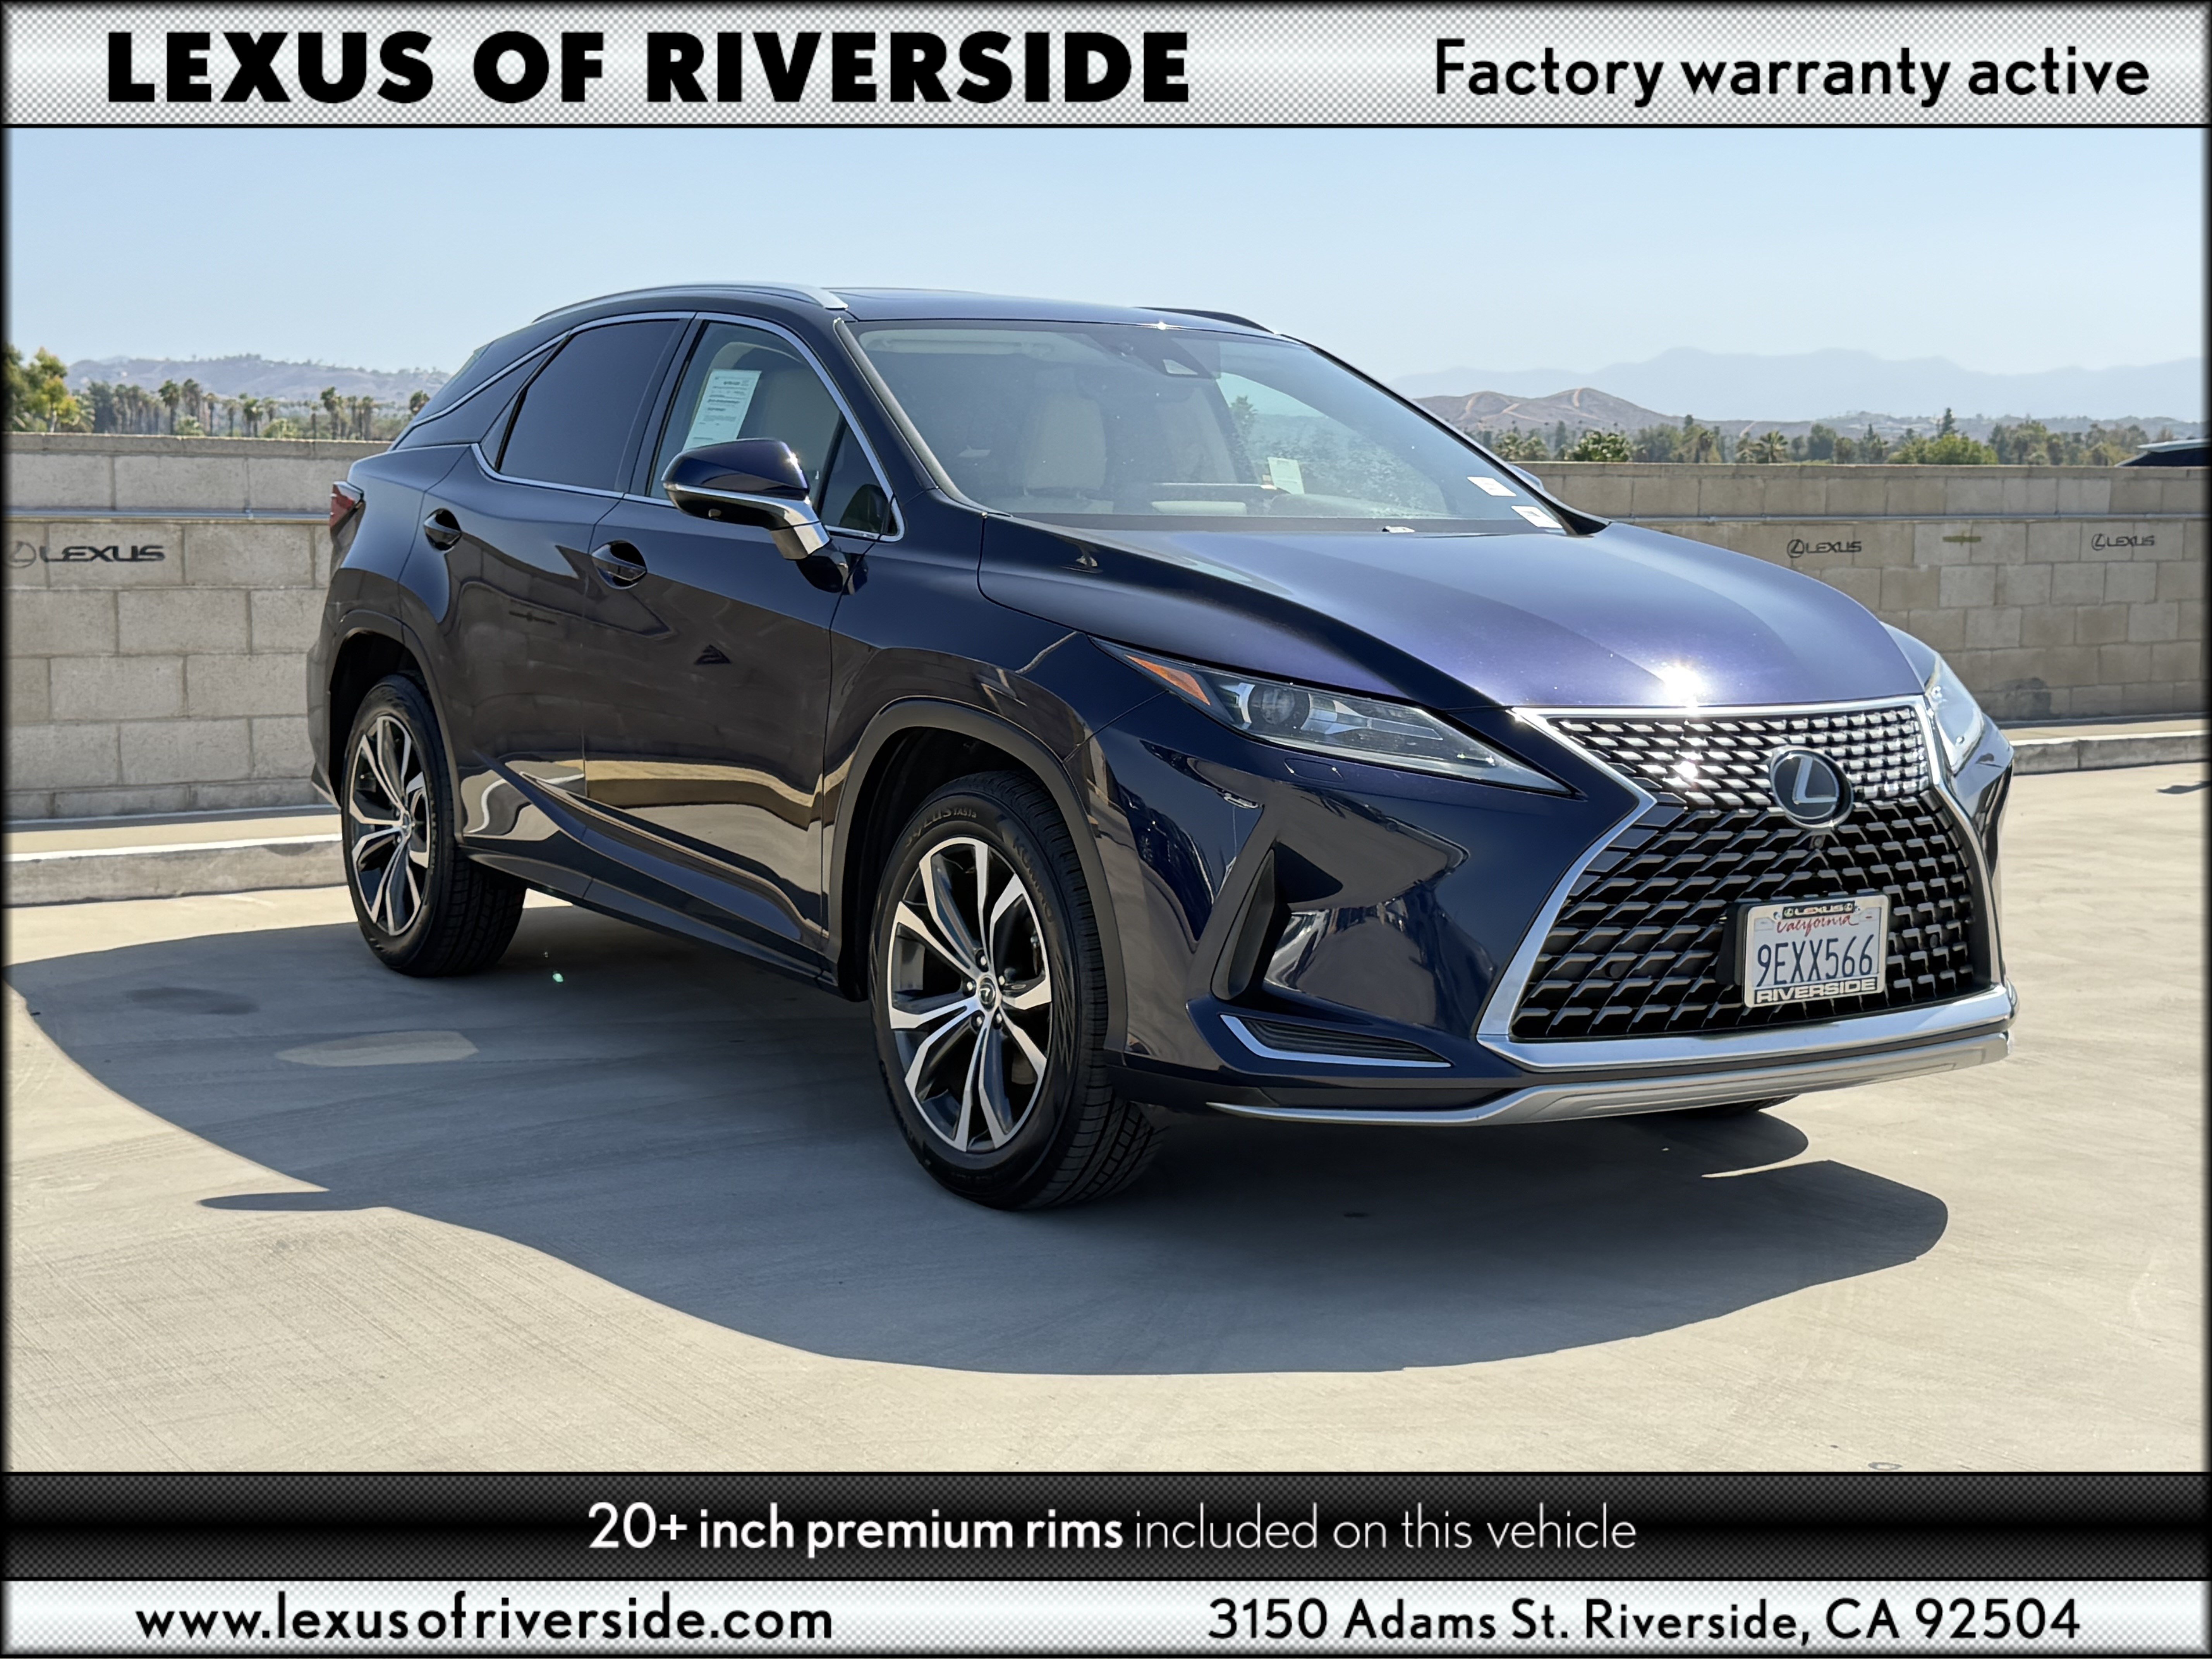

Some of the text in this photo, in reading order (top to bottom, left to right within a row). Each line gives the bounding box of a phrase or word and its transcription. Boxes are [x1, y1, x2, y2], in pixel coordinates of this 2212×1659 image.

[1806, 541, 1862, 553] LEXUS
[2107, 535, 2154, 546] LEXUS
[40, 545, 165, 563] LEXUS
[1795, 904, 1844, 915] LEXUS
[1777, 915, 1858, 937] California
[1757, 934, 1874, 987] 9EXX566
[1757, 978, 1876, 1003] RIVERSIDE
